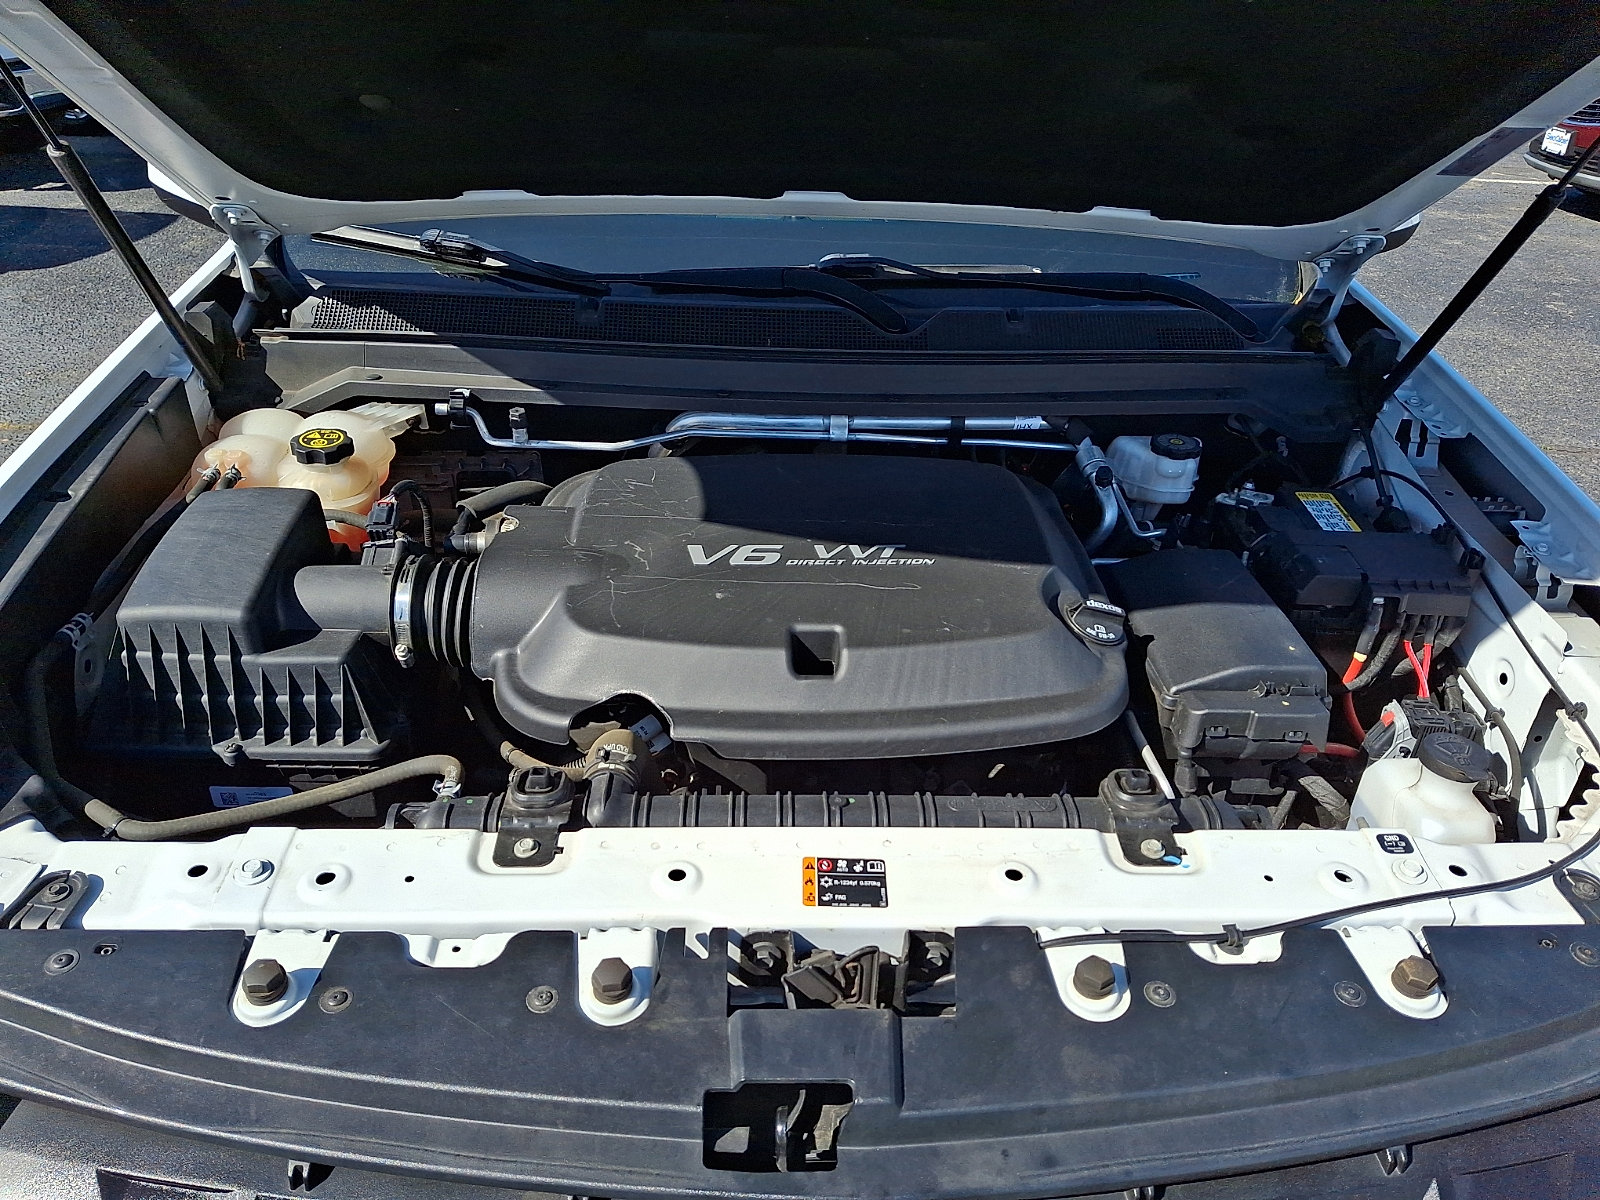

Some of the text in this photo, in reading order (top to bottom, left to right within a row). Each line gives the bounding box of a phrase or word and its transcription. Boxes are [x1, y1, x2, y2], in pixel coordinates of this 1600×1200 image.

[687, 544, 784, 566] V6
[813, 544, 906, 559] VVT
[851, 558, 935, 566] INJECTION
[1086, 600, 1122, 613] dexos
